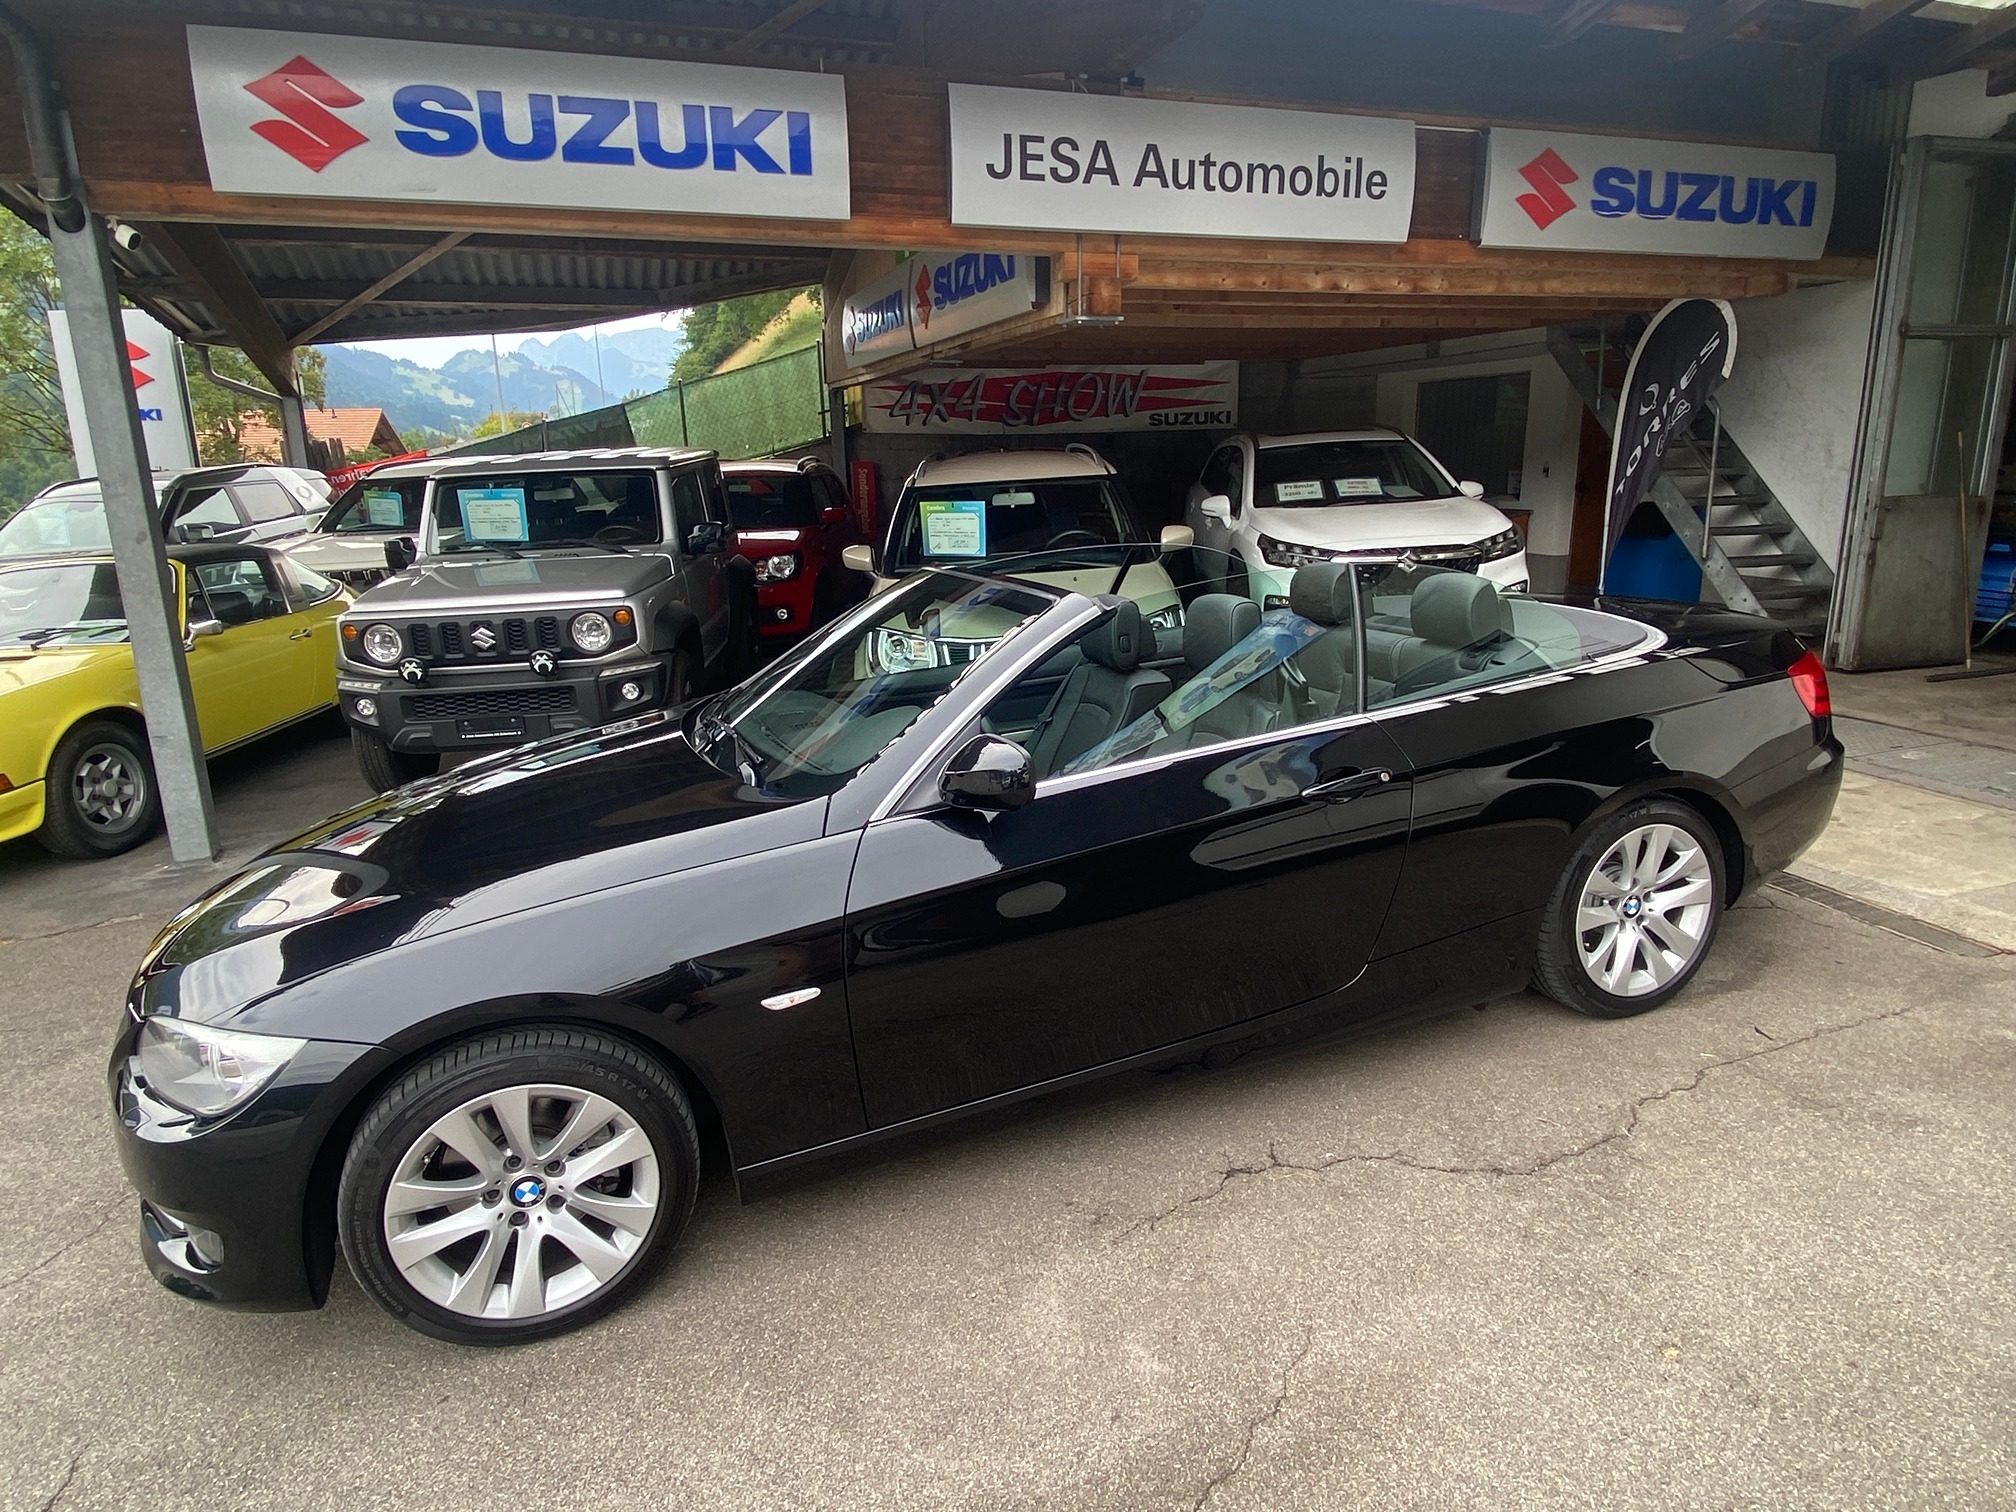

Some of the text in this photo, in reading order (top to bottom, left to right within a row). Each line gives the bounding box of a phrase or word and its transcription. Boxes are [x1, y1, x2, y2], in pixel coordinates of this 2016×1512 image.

[393, 84, 813, 177] SUZUKI
[985, 133, 1388, 201] JESA Automobile
[1591, 166, 1817, 228] SUZUKI
[1000, 368, 1150, 428] SHOW
[1147, 410, 1232, 427] SUZUKI
[1614, 331, 1721, 496] TORRES
